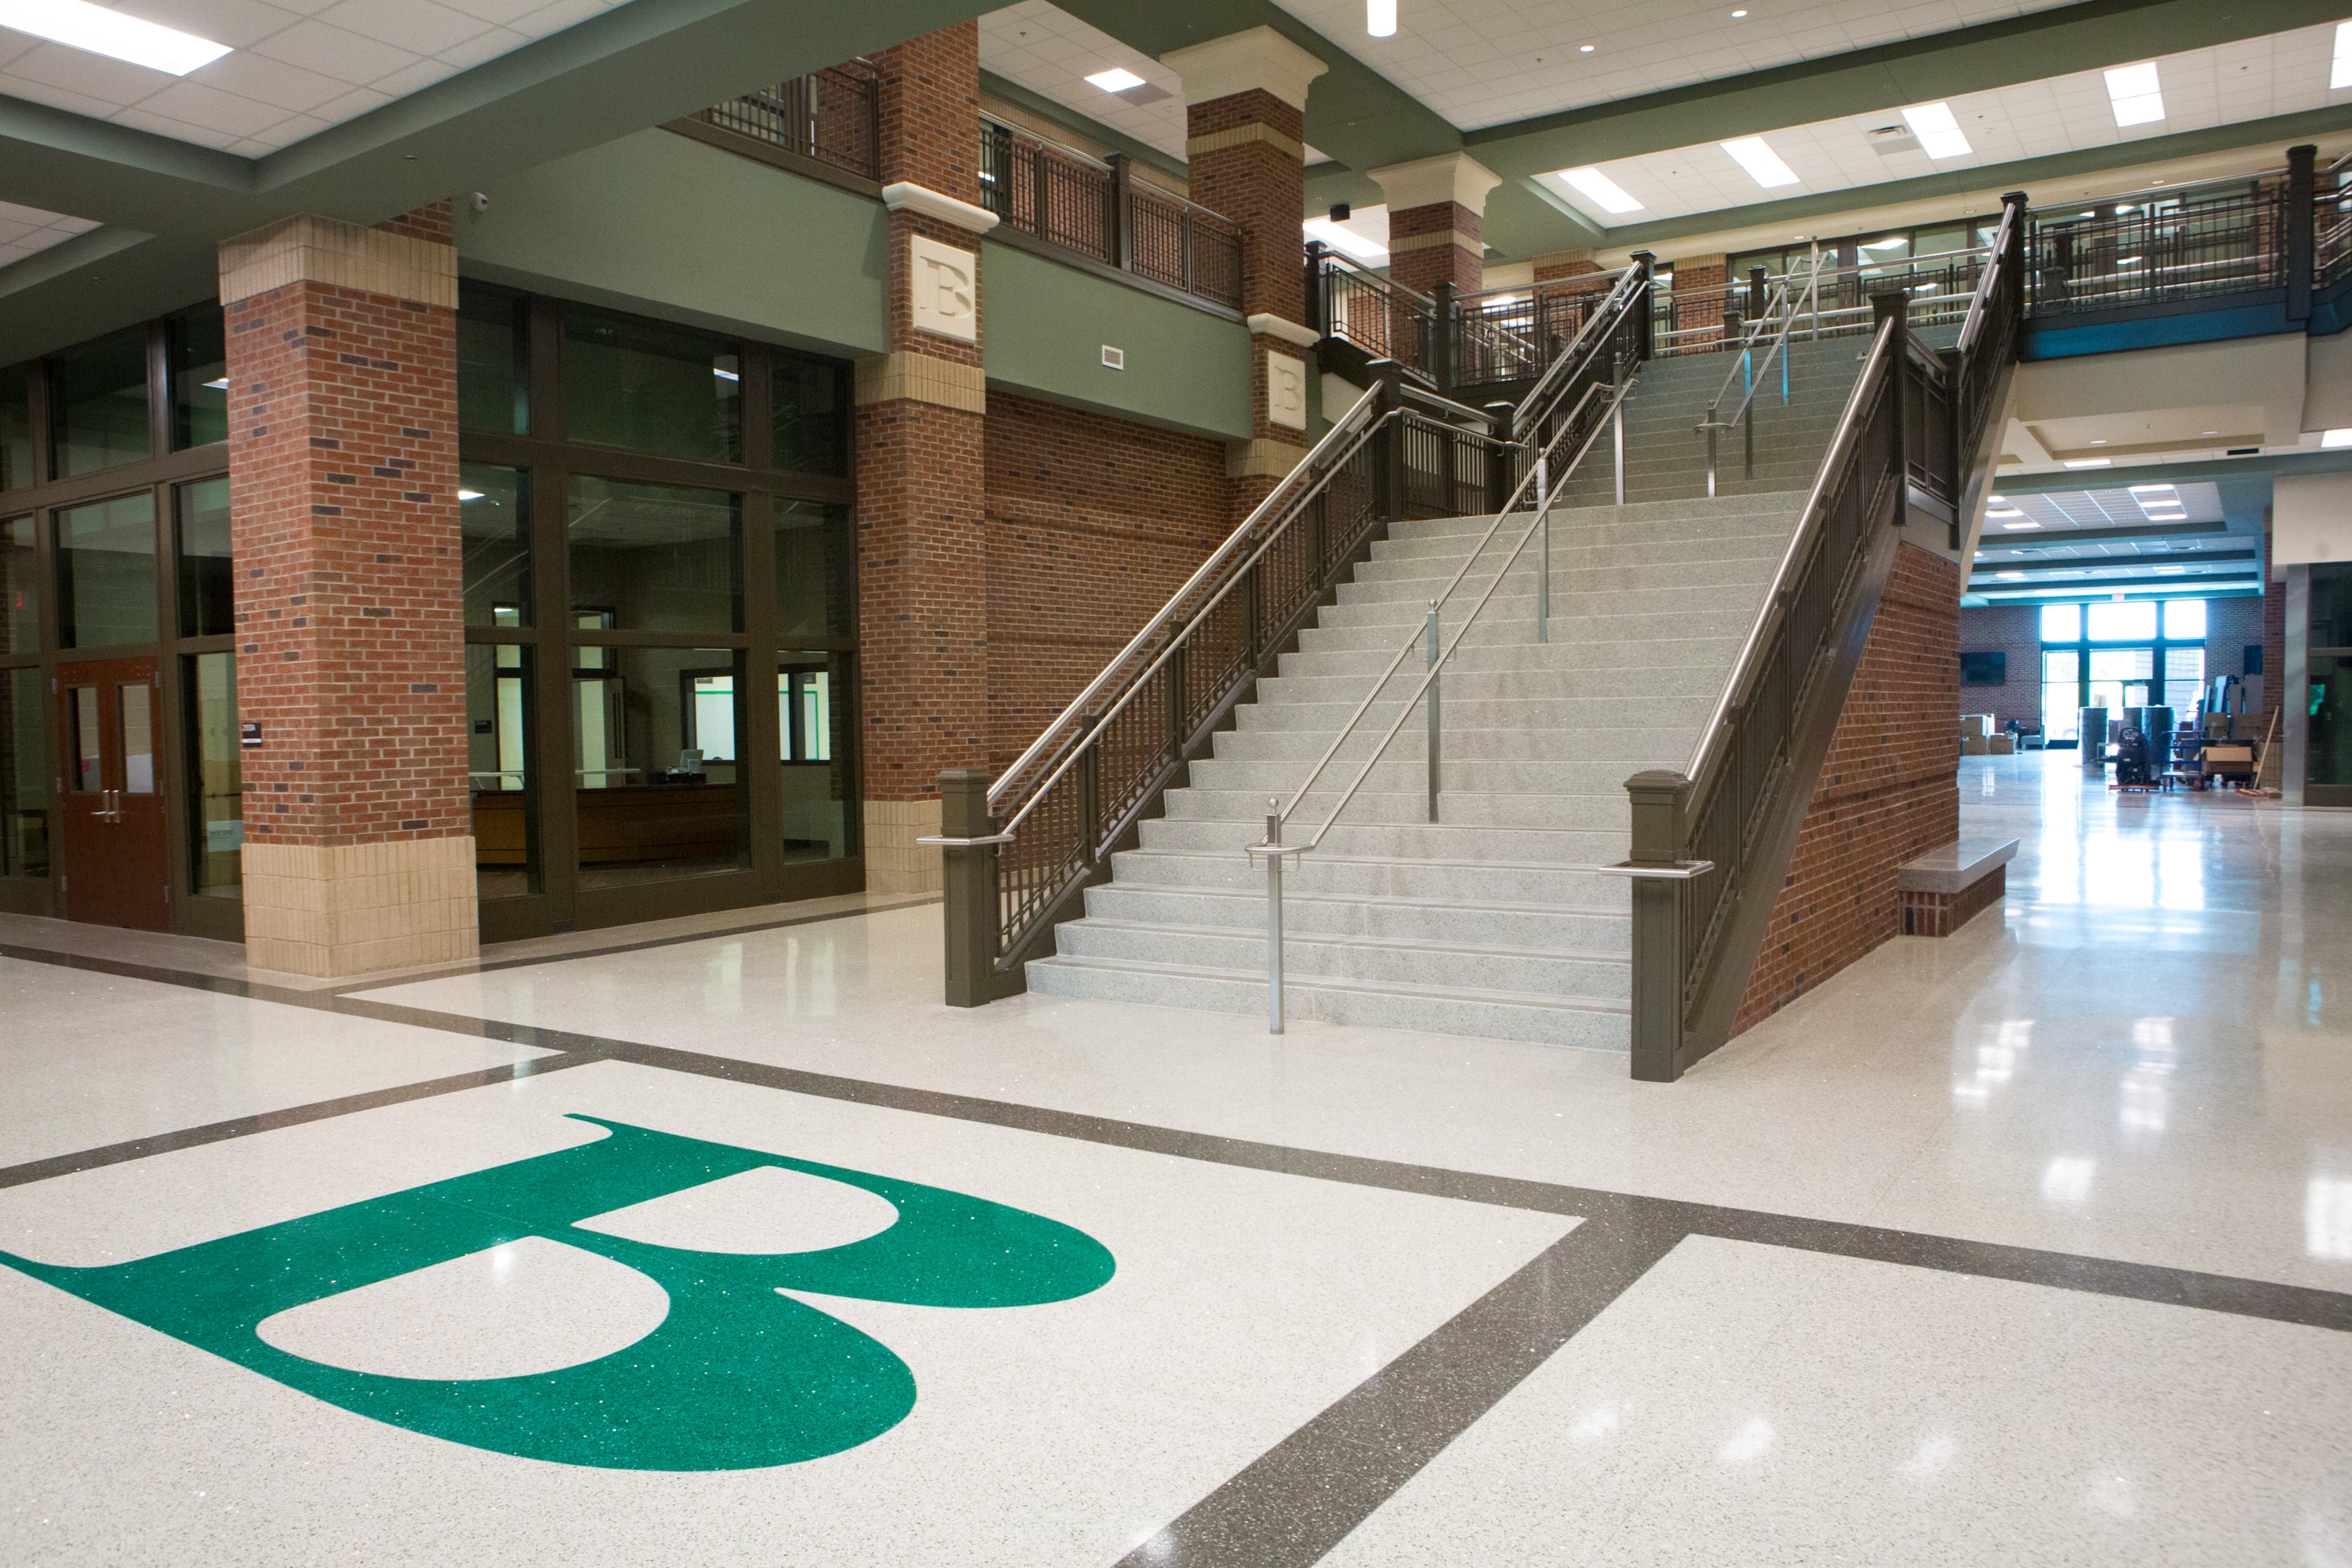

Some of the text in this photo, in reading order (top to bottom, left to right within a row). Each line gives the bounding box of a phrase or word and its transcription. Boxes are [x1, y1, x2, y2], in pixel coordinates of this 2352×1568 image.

[919, 255, 973, 320] B
[1273, 366, 1303, 412] B
[0, 1113, 1116, 1472] B
